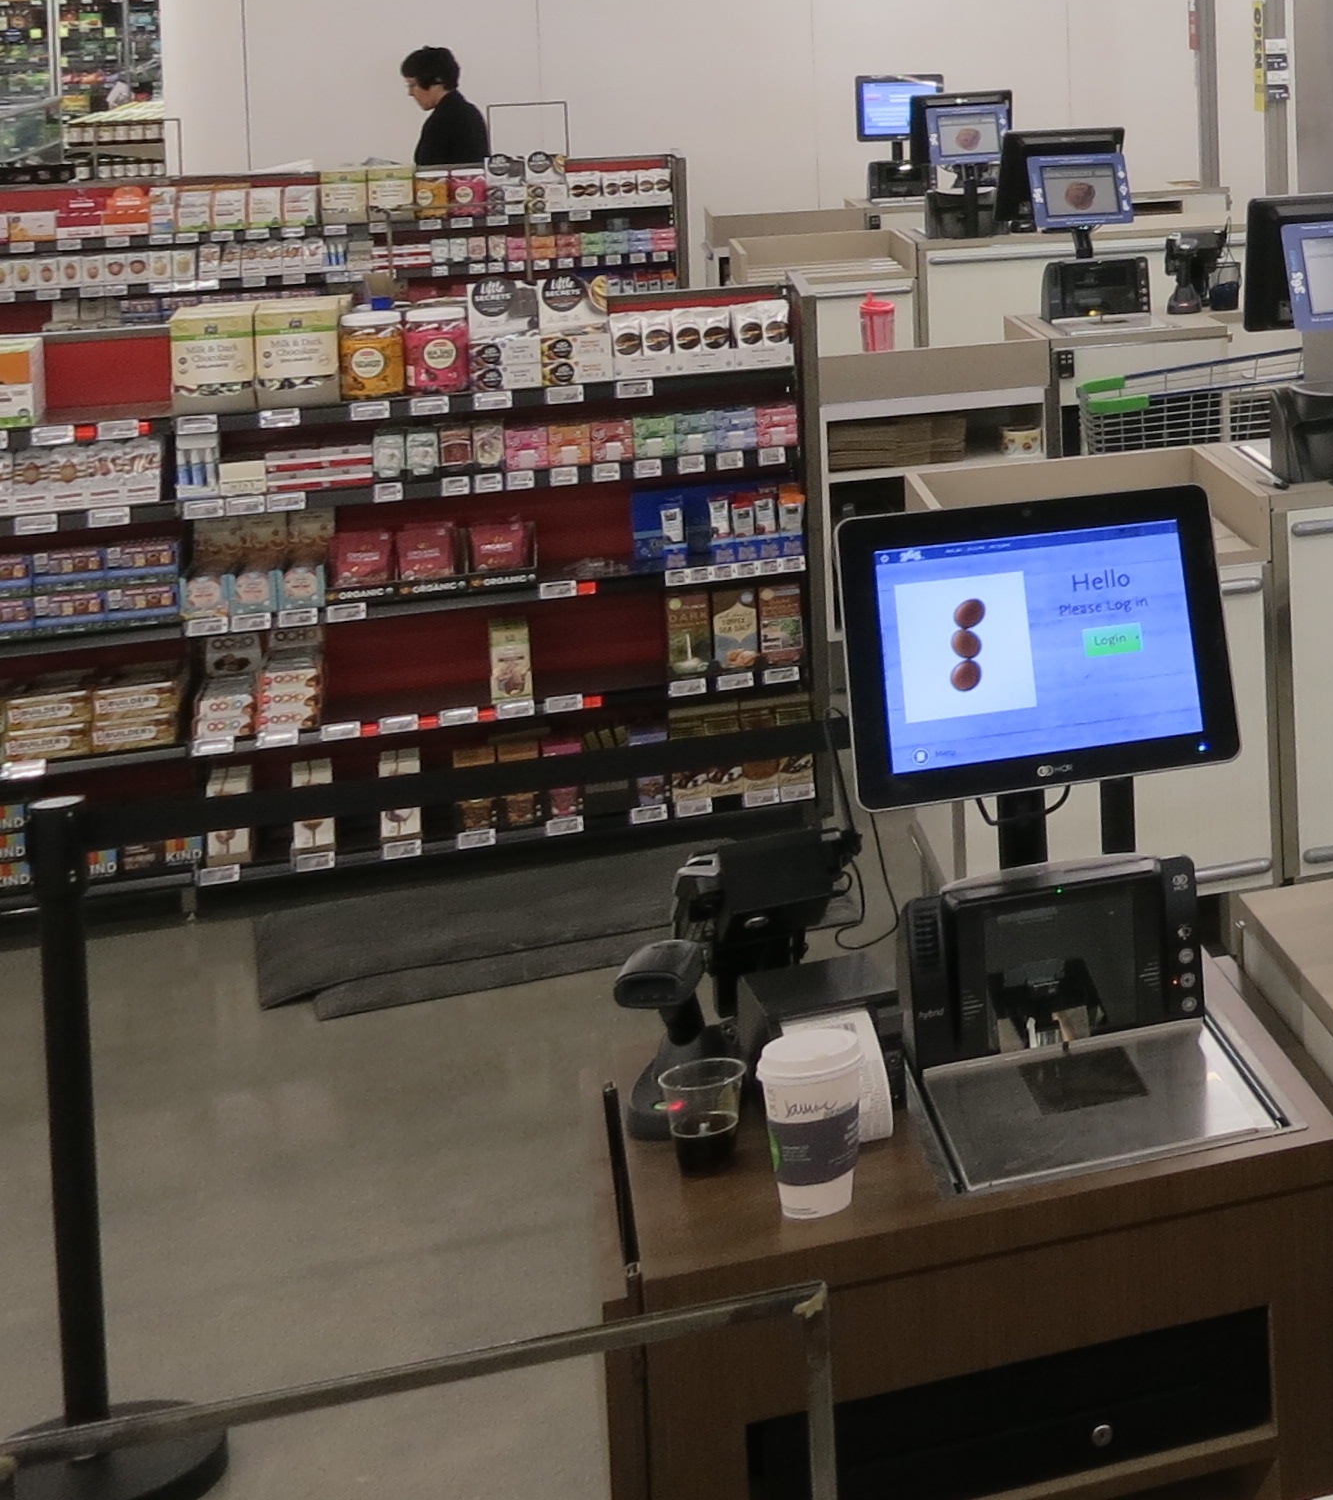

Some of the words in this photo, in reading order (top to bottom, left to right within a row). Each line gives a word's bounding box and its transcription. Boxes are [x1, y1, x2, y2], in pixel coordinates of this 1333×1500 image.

[1253, 7, 1264, 70] OPEN
[482, 574, 527, 587] ORGANIC
[1071, 568, 1131, 592] Hello
[338, 587, 385, 600] ORGANIC
[412, 581, 458, 594] ORGANIC
[1059, 603, 1102, 617] Please
[1106, 599, 1132, 614] Log
[1135, 596, 1149, 608] in
[1093, 633, 1128, 647] Login
[0, 816, 25, 830] IND
[0, 845, 26, 859] IND
[165, 849, 203, 863] KIND
[89, 861, 118, 875] IND
[917, 1006, 945, 1021] hybrid
